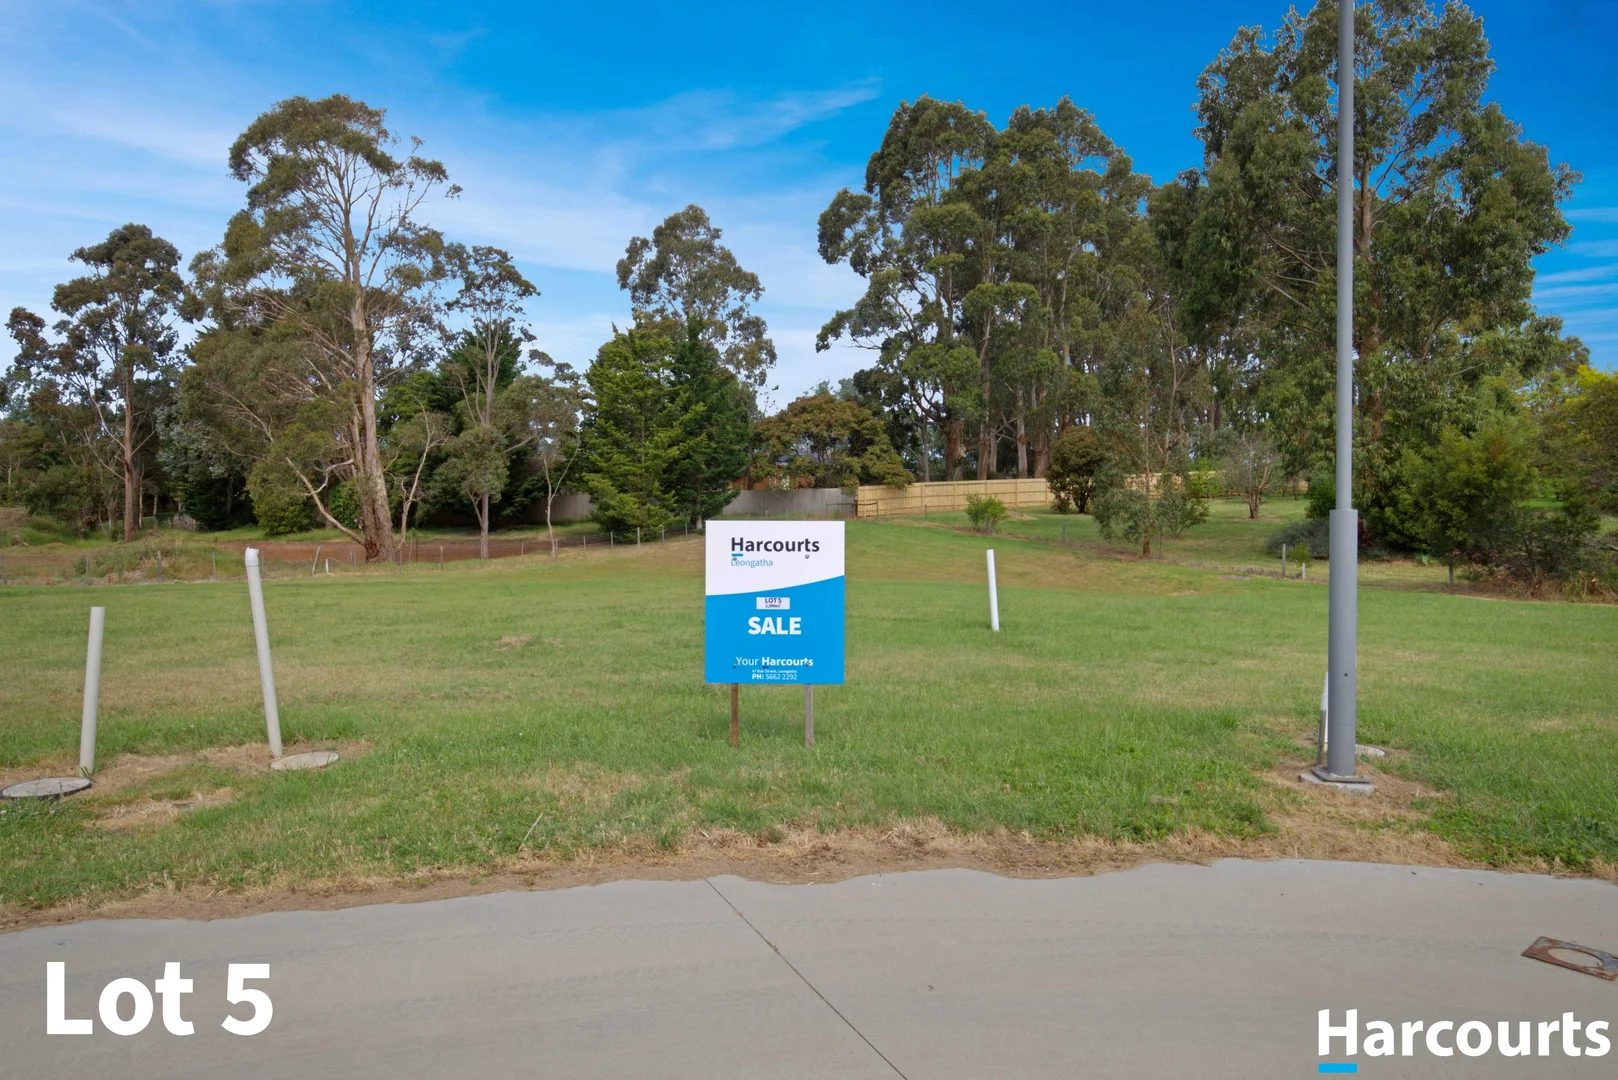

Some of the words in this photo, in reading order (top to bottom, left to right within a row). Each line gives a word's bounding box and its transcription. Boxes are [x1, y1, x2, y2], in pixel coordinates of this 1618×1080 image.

[731, 537, 820, 552] Harcourts
[731, 558, 773, 568] Leongatha
[748, 616, 802, 635] SALE
[736, 657, 759, 666] Your
[761, 657, 814, 666] Harcourts
